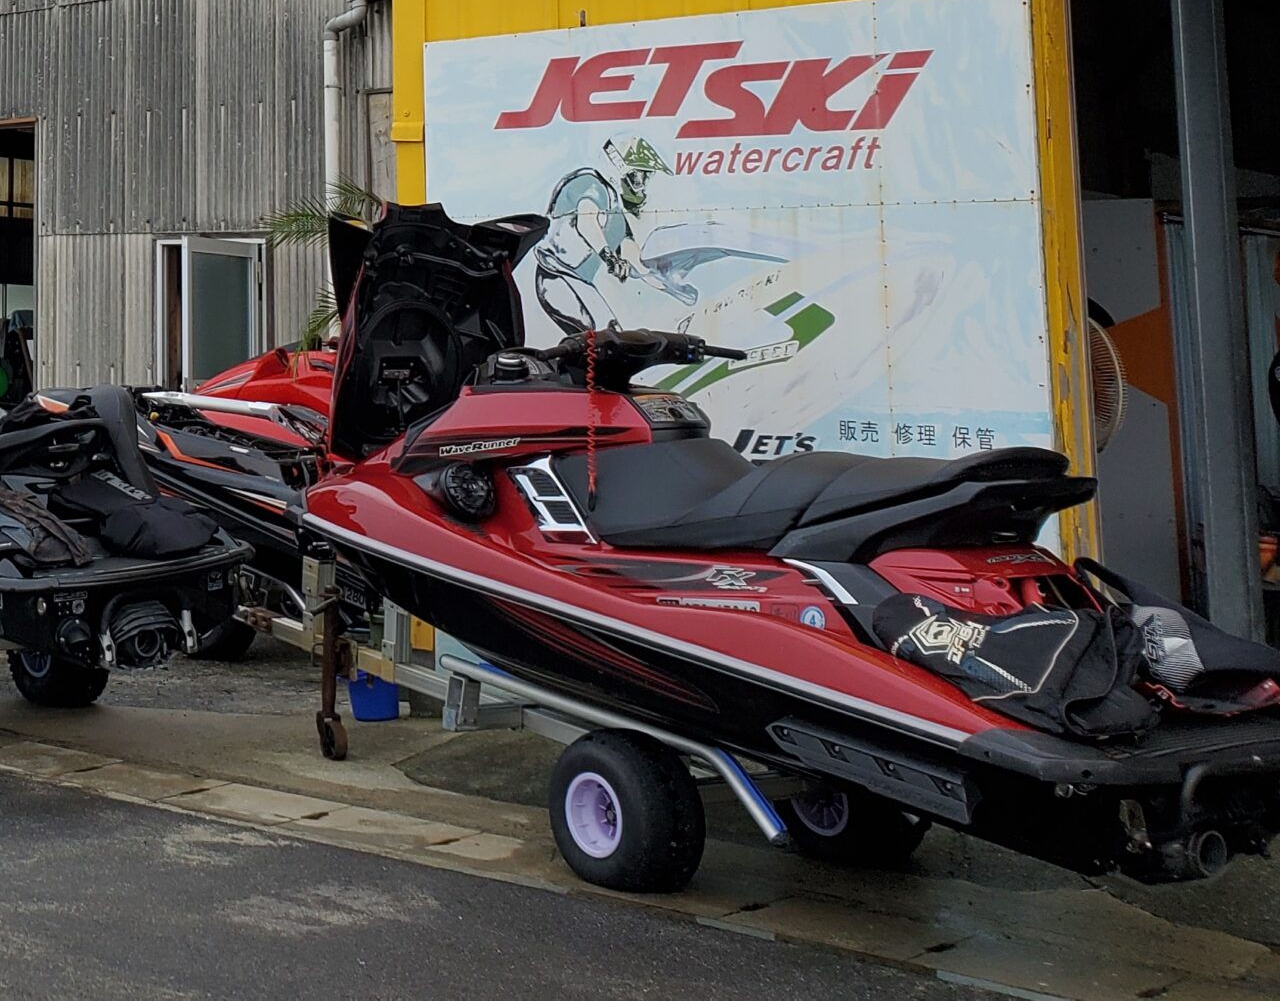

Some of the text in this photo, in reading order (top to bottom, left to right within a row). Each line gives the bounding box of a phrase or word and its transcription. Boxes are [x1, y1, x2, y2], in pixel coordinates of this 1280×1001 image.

[494, 41, 744, 129] JET
[675, 136, 881, 175] watercraft
[439, 438, 520, 456] WaveRunner
[839, 420, 995, 450] 販売 修理 保管
[705, 565, 756, 586] FX
